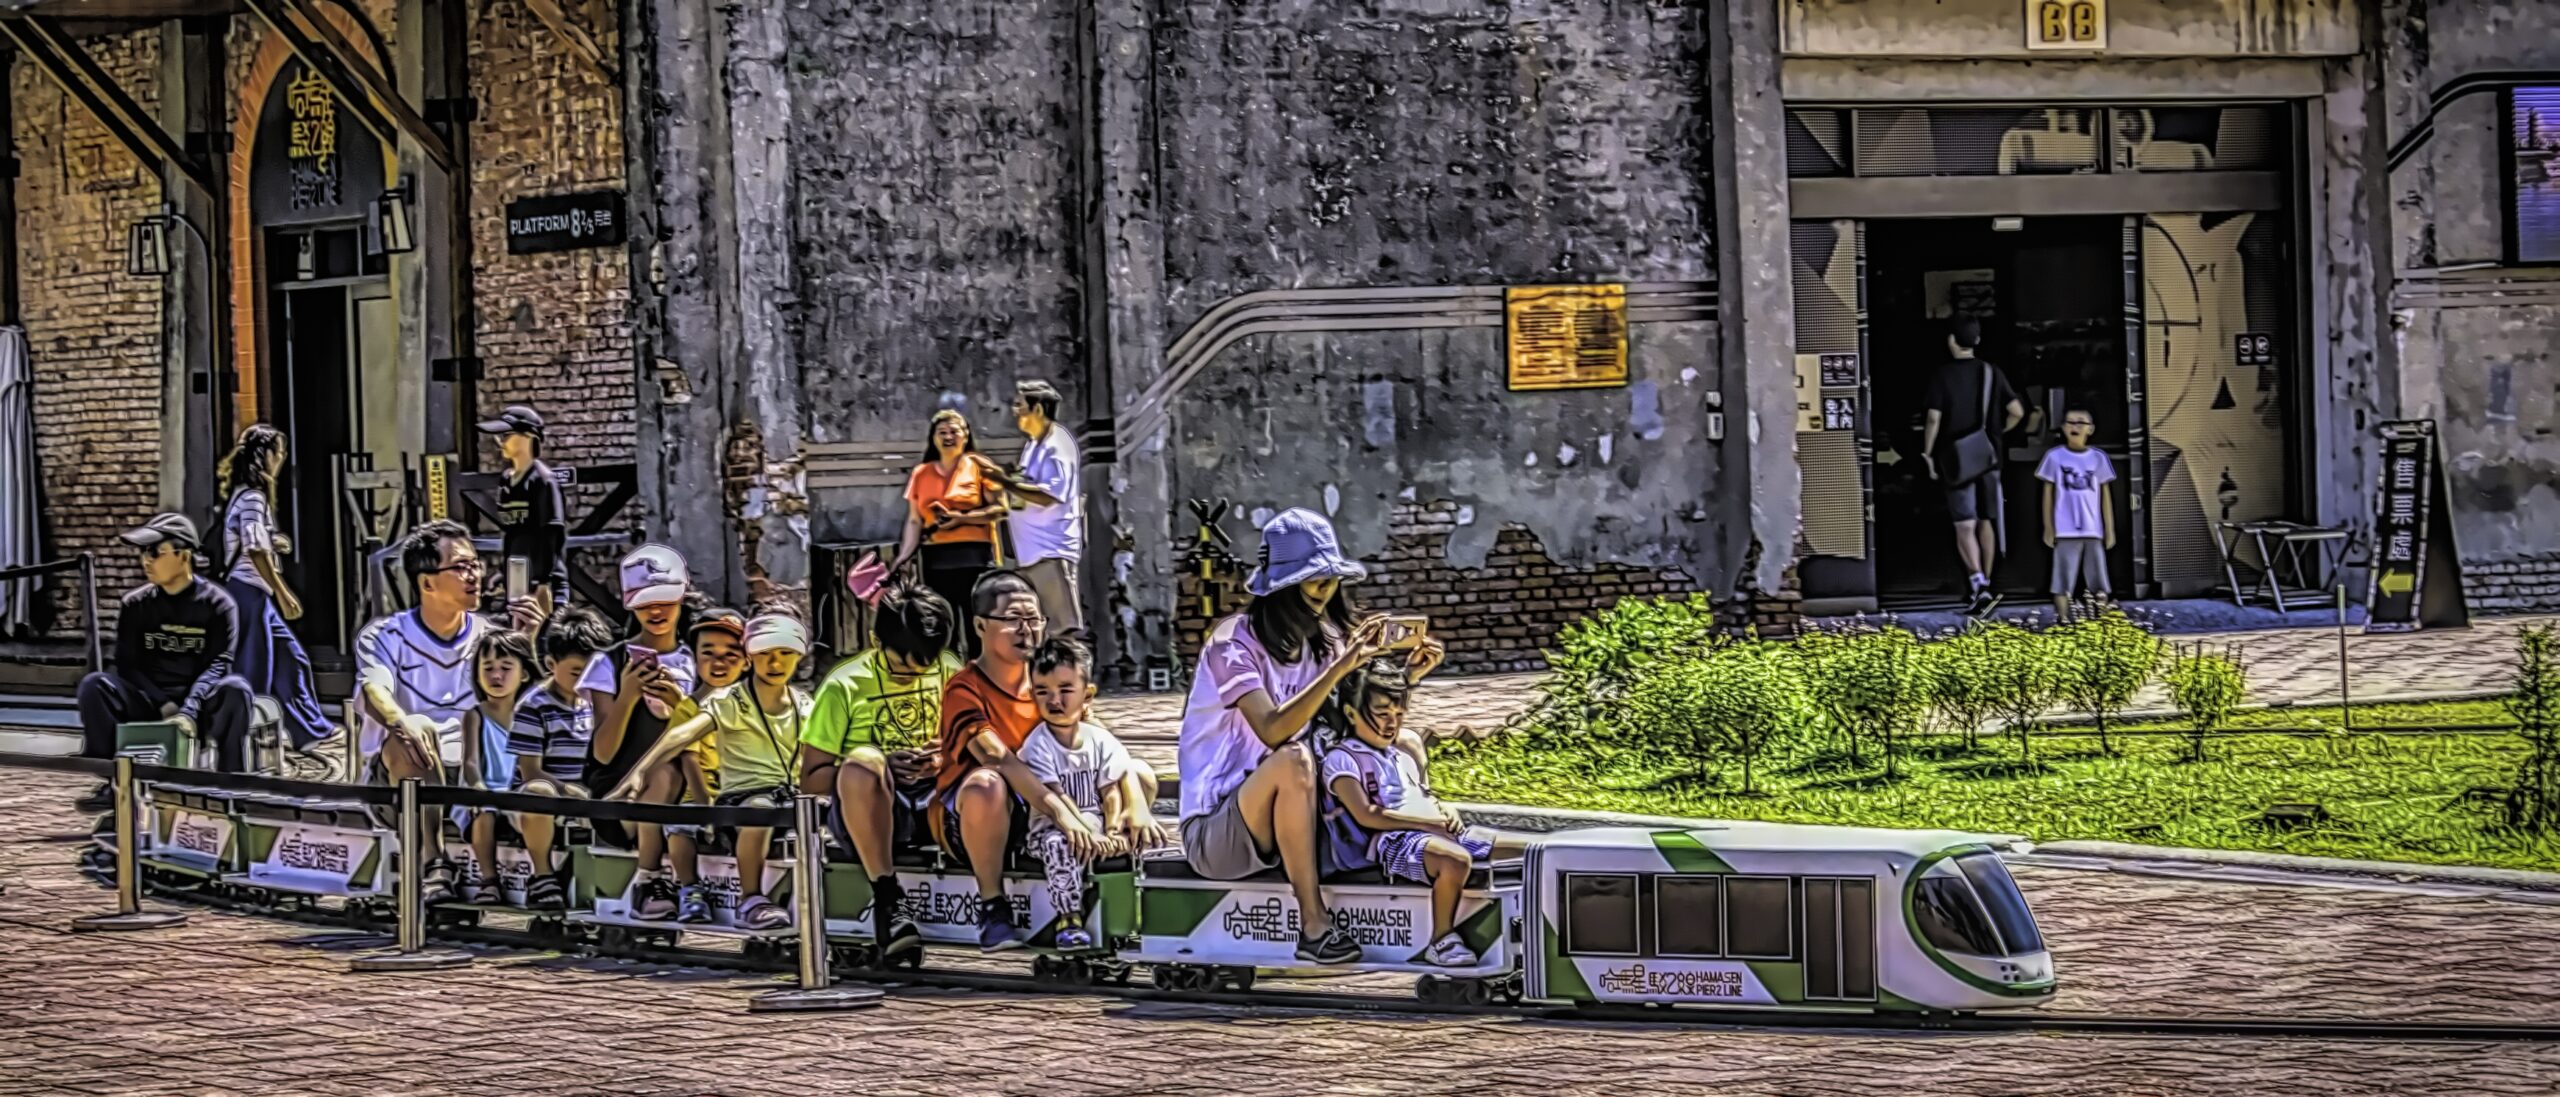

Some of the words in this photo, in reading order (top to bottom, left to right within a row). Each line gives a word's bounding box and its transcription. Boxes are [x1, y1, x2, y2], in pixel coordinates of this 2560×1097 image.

[510, 214, 569, 235] PLATFORM
[1513, 893, 1520, 911] 1
[1350, 908, 1412, 928] HAMASEN
[1351, 927, 1384, 947] PIER2
[1387, 928, 1412, 947] LINE
[1696, 971, 1743, 985] HAMASEN
[1696, 984, 1722, 997] PIER2
[1724, 984, 1743, 997] LINE
